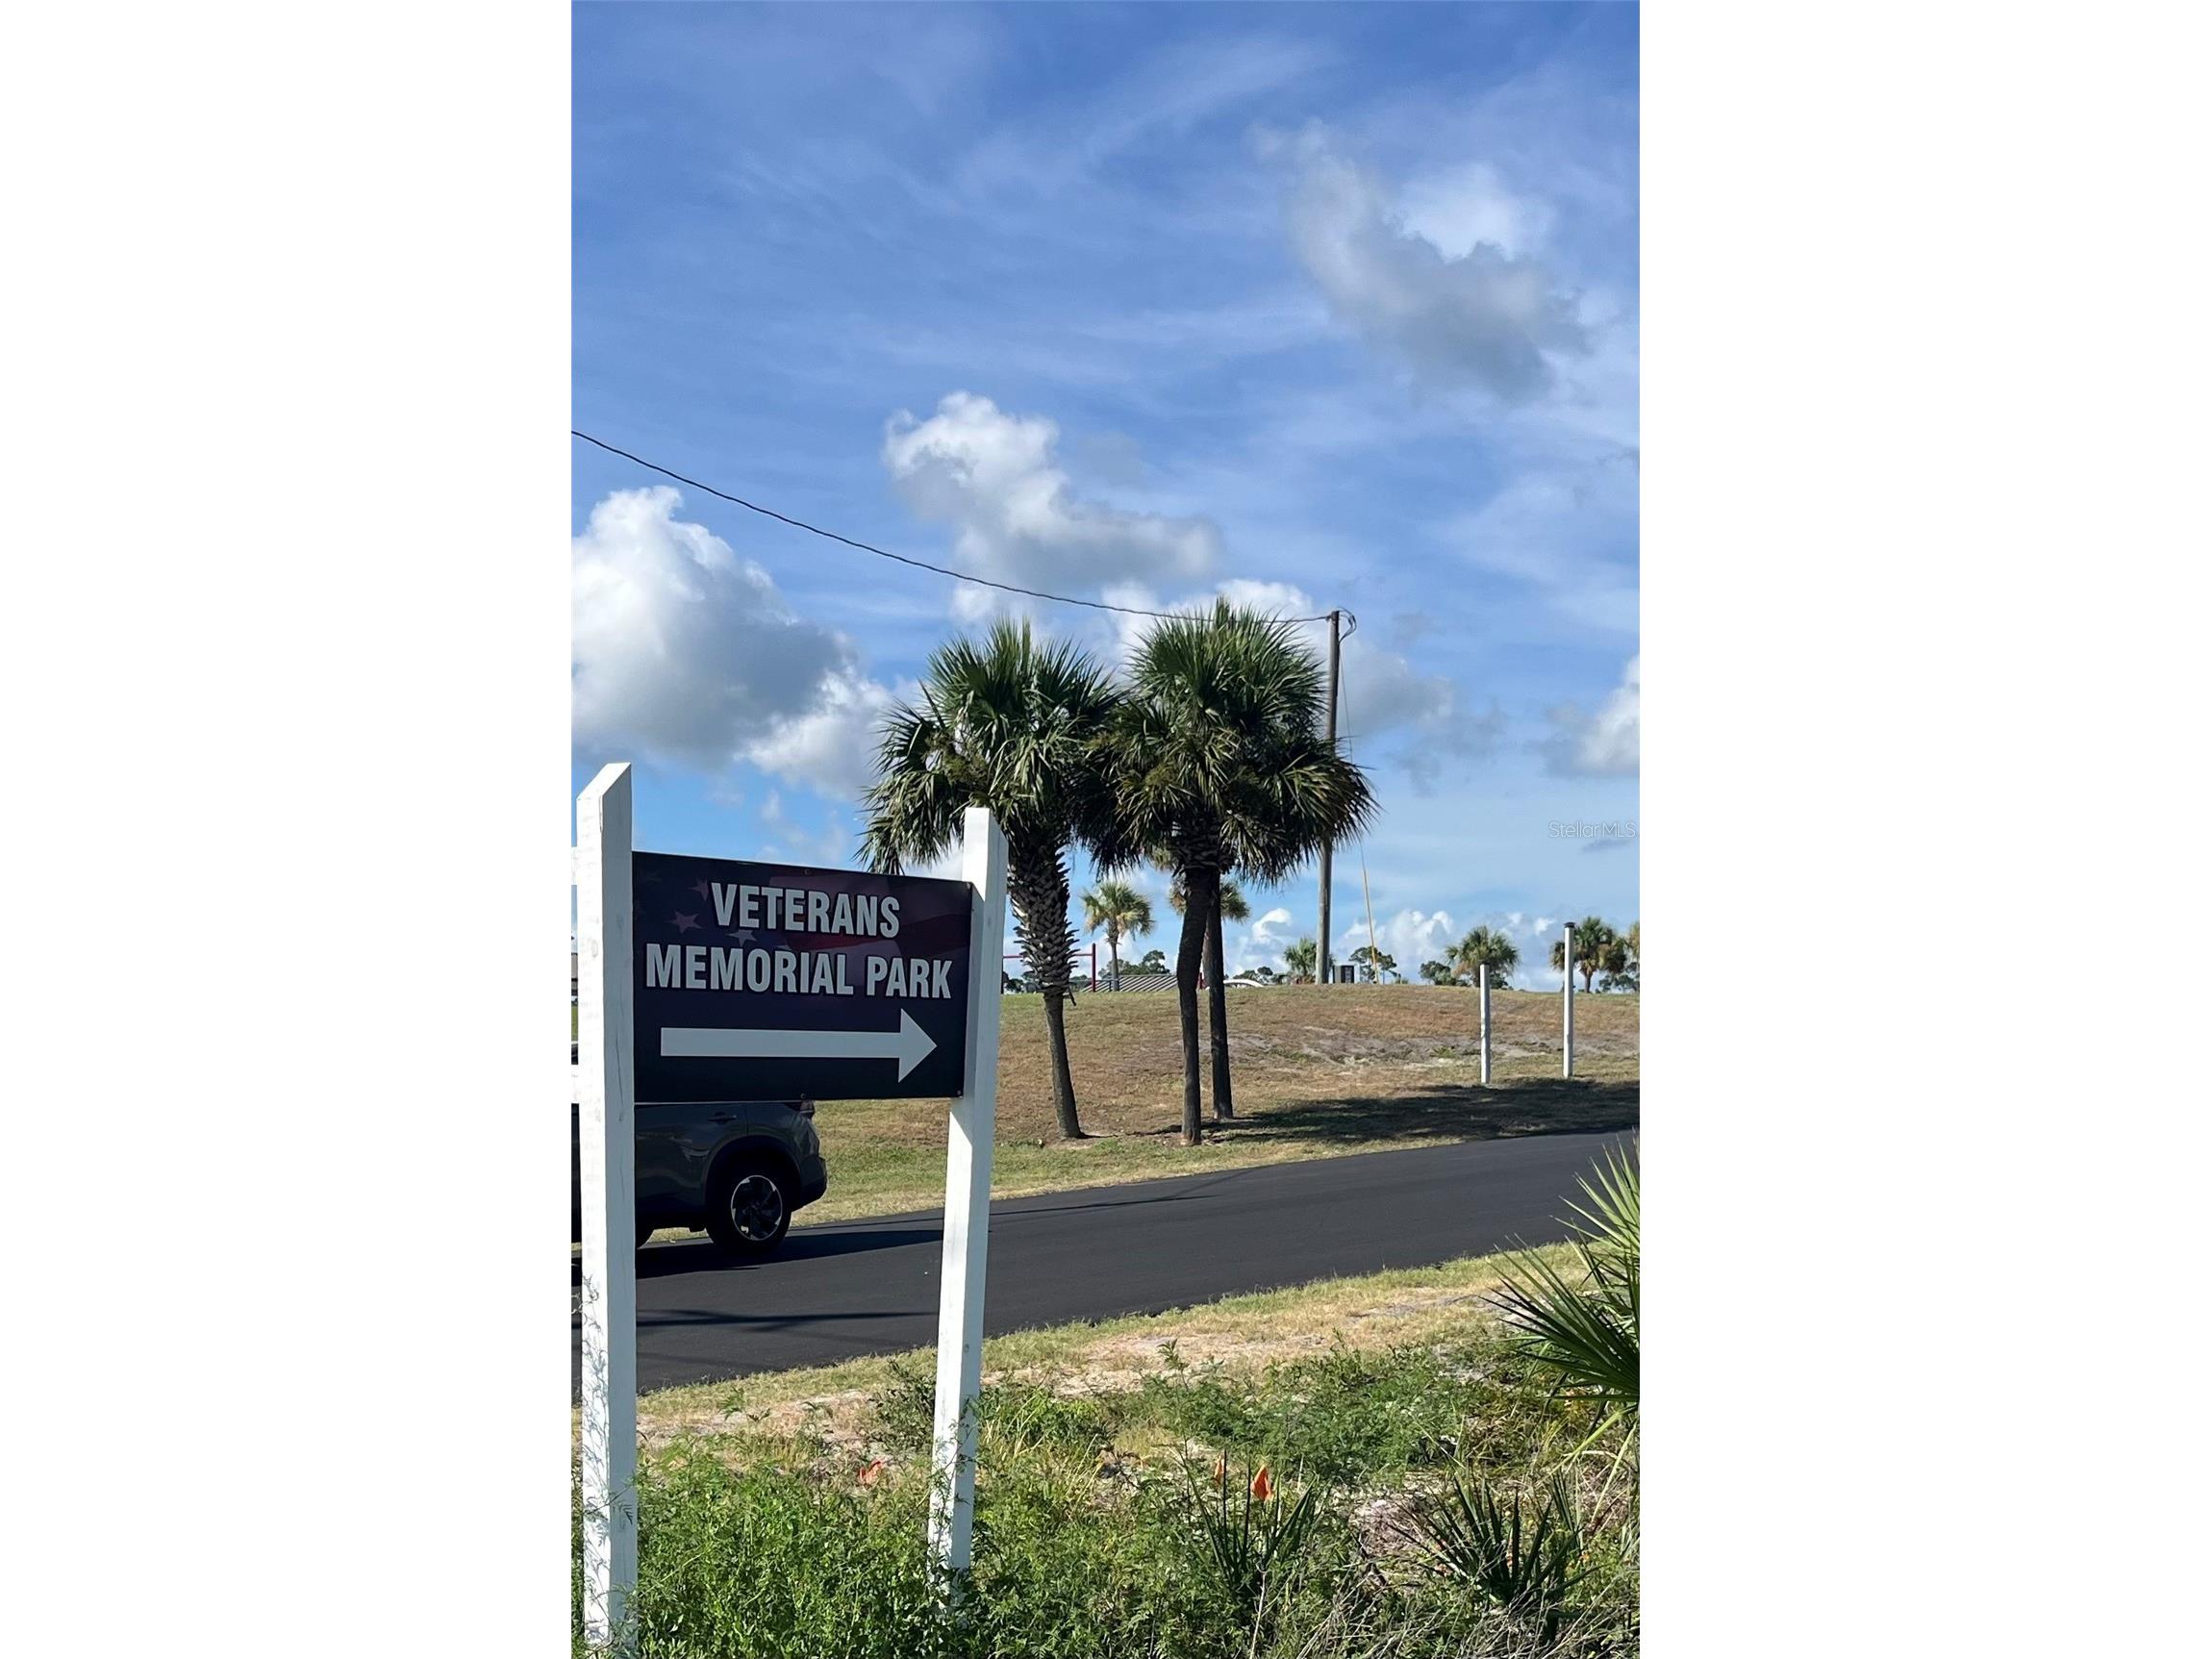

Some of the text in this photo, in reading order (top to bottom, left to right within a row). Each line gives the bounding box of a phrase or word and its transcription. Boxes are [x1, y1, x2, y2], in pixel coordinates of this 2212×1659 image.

[712, 882, 900, 939] VETERANS
[645, 943, 953, 999] MEMORIAL PARK
